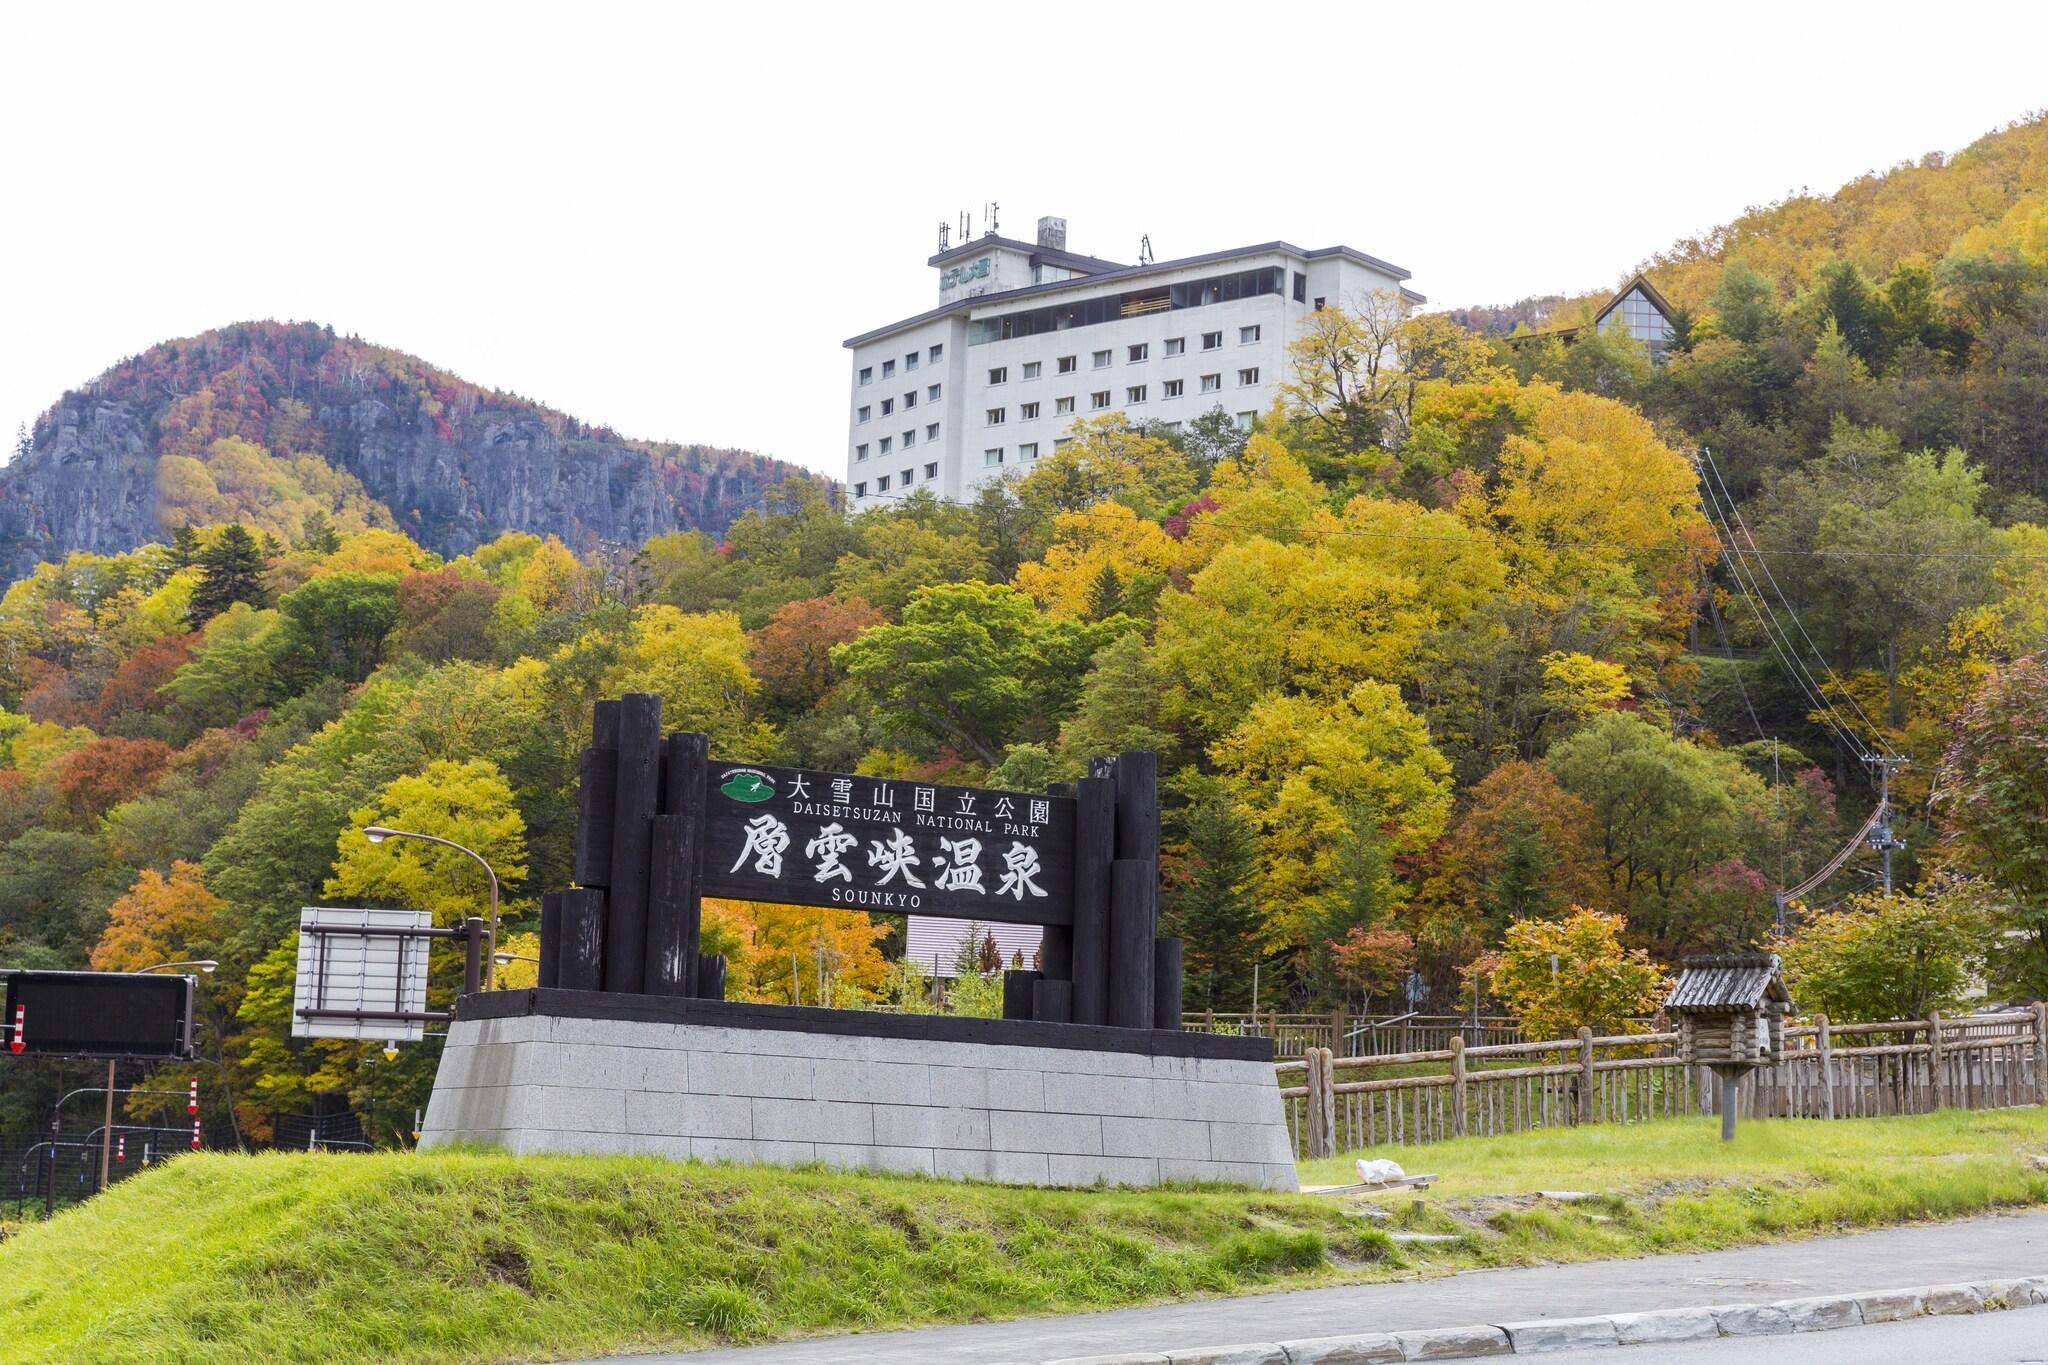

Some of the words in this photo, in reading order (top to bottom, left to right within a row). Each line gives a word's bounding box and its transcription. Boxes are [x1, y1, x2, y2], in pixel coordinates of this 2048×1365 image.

[787, 774, 1049, 824] 大雪山国立公園
[793, 802, 901, 823] DAISETSUZAN
[917, 814, 993, 832] NATIONAL
[1004, 823, 1040, 837] PARK
[730, 813, 1048, 900] 層雲峡温泉
[832, 887, 921, 908] SOUNKYO
